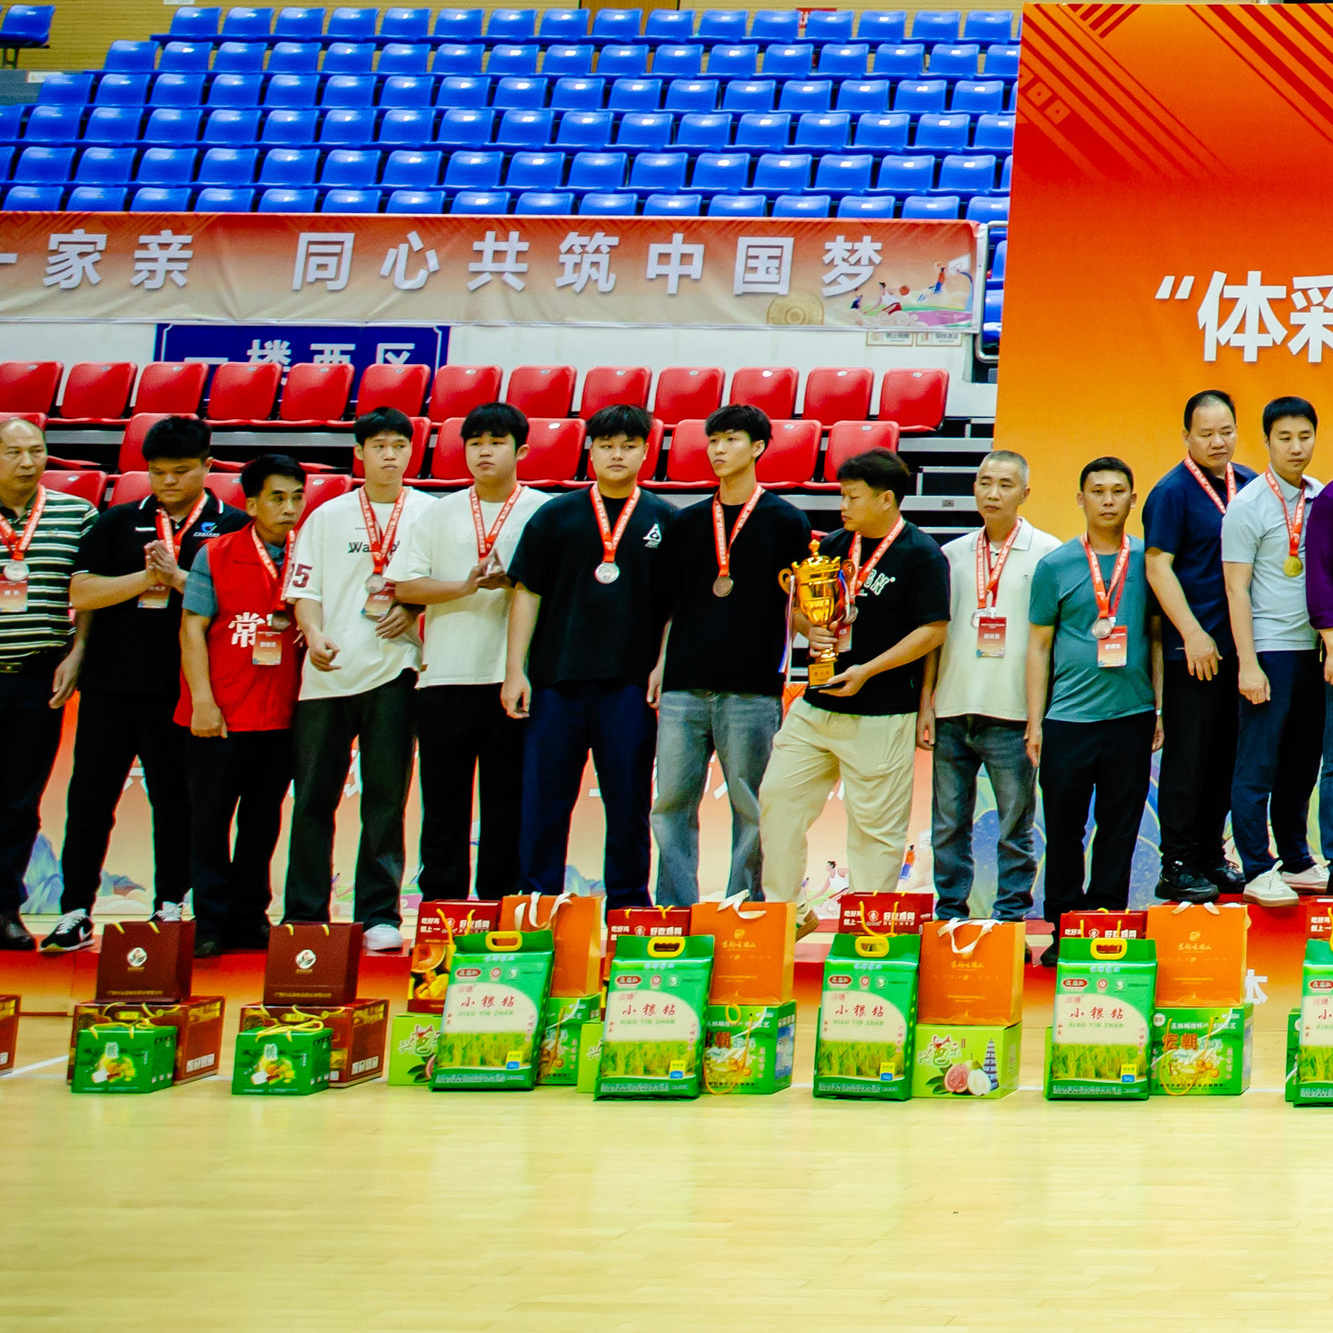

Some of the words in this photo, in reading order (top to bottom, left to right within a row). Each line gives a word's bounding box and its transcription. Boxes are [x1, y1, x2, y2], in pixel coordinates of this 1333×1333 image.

[293, 230, 884, 297] 同心共筑中国梦
